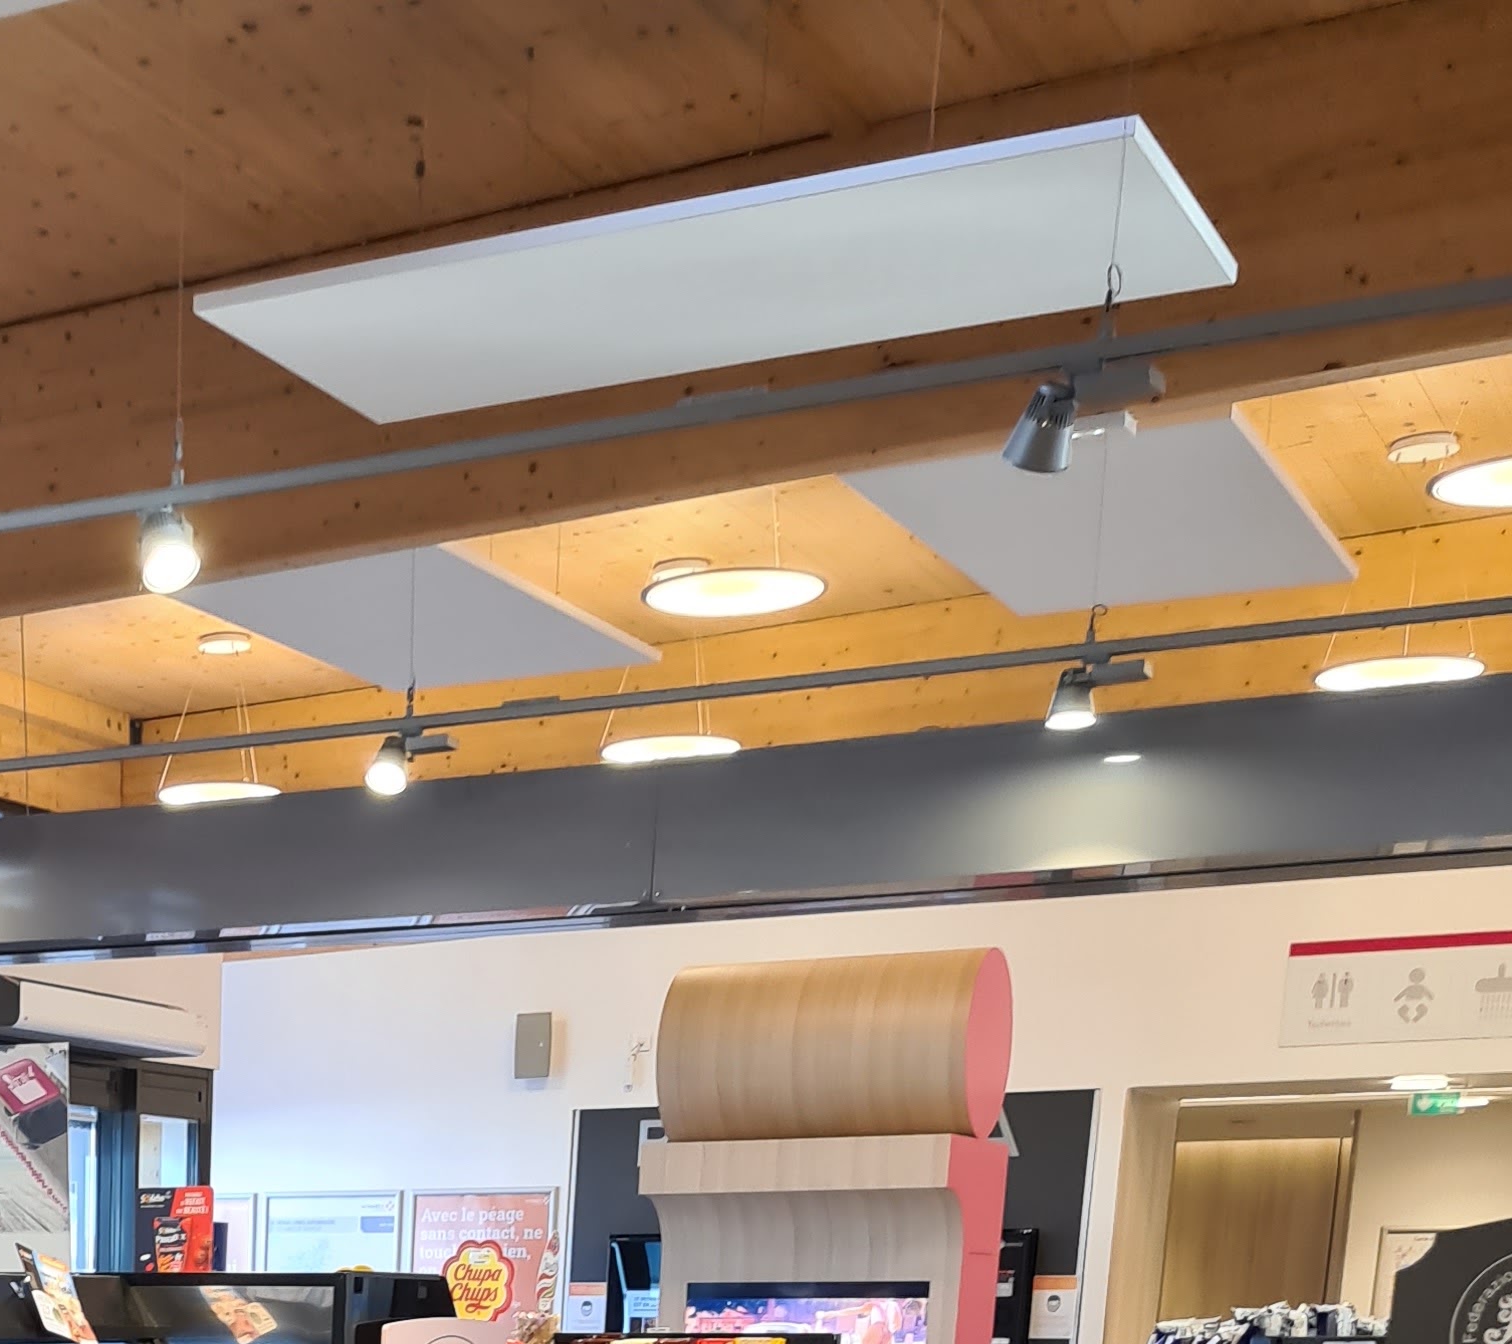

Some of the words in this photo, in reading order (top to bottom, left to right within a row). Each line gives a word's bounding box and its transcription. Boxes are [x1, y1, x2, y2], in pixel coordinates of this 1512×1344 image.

[421, 1208, 458, 1223] Avec
[461, 1207, 475, 1222] le
[479, 1206, 524, 1224] péage
[420, 1229, 455, 1241] sans
[459, 1226, 520, 1243] contact,
[523, 1228, 543, 1240] ne
[453, 1263, 503, 1286] Chupa
[451, 1283, 499, 1302] Chups
